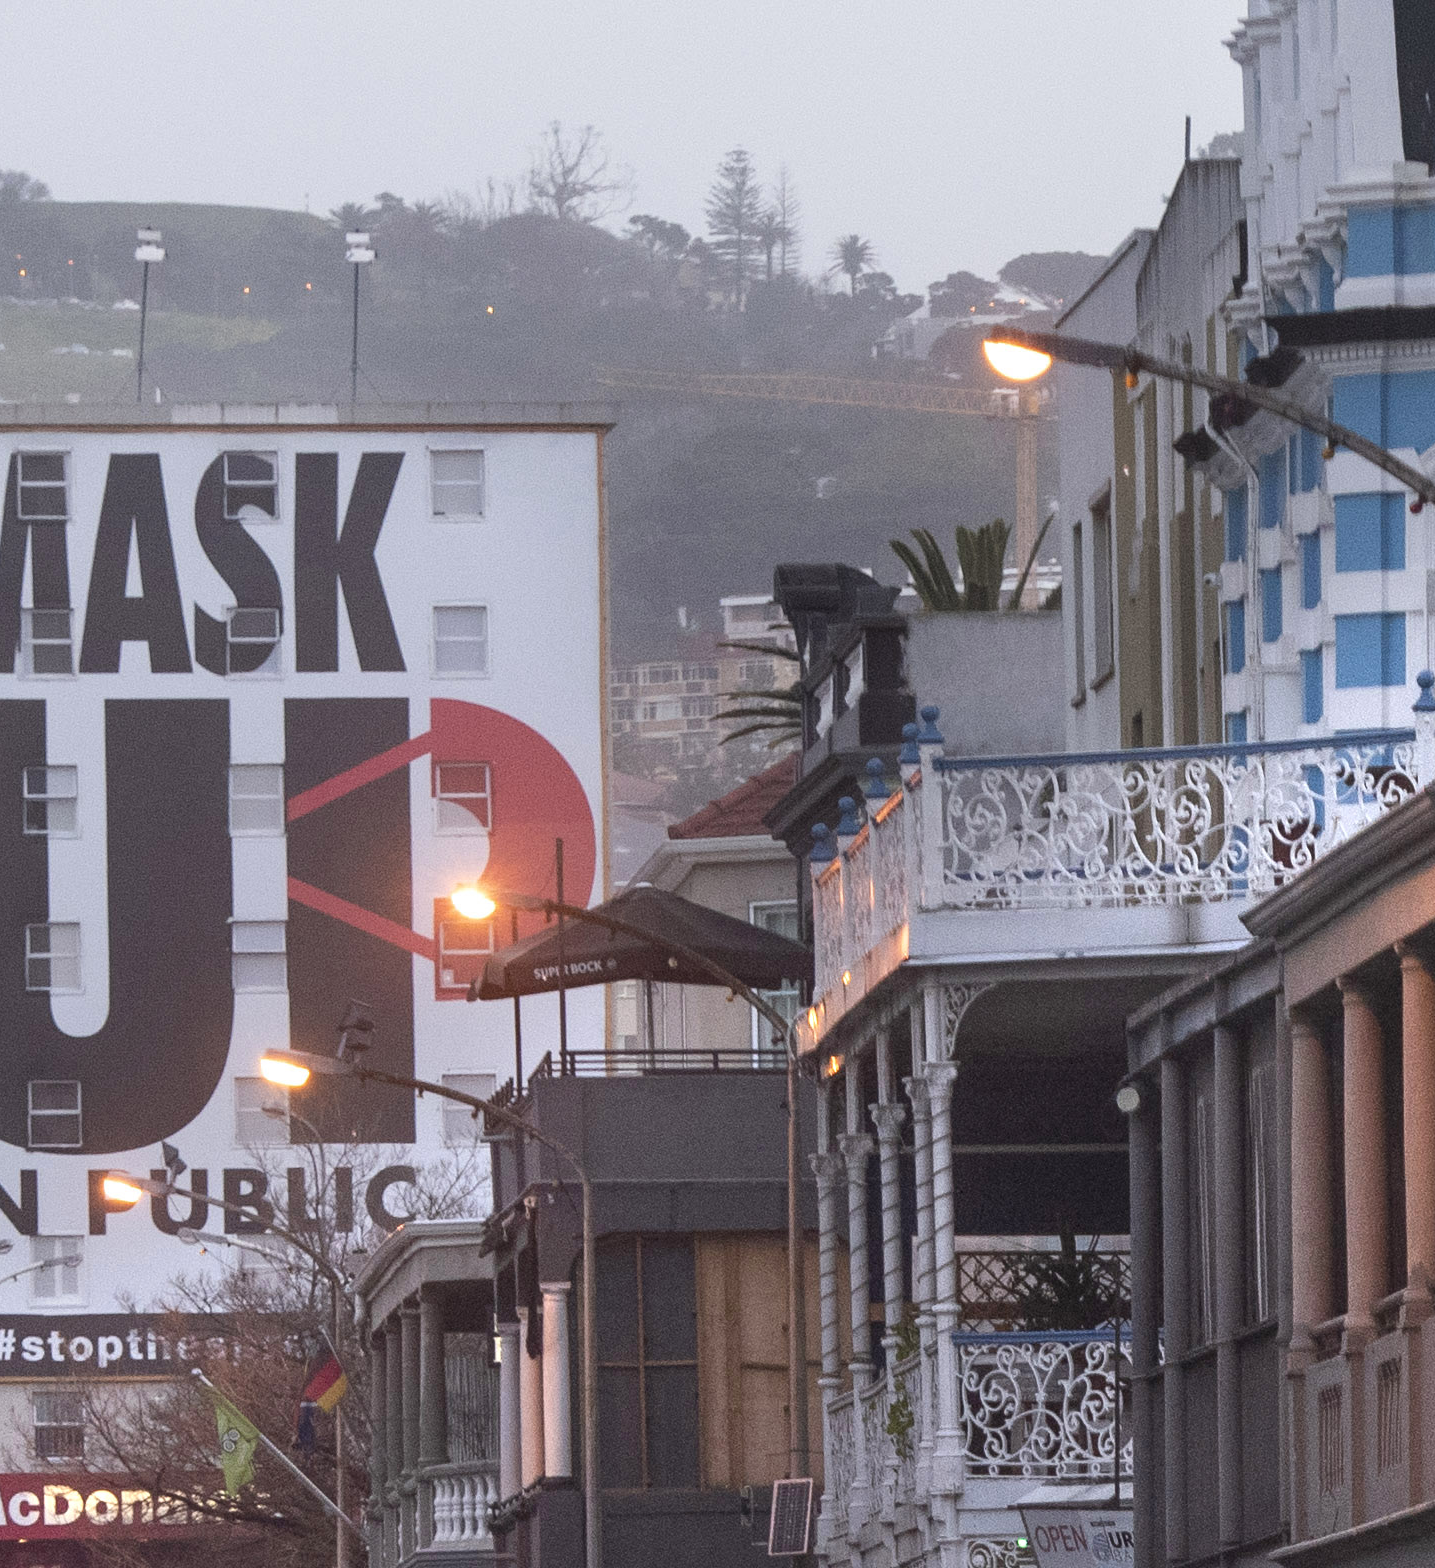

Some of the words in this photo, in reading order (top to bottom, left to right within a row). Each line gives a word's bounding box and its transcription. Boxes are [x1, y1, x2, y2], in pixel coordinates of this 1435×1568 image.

[570, 959, 603, 975] BOCK
[88, 1164, 418, 1237] PUBLIC
[1034, 1525, 1088, 1553] OPEN
